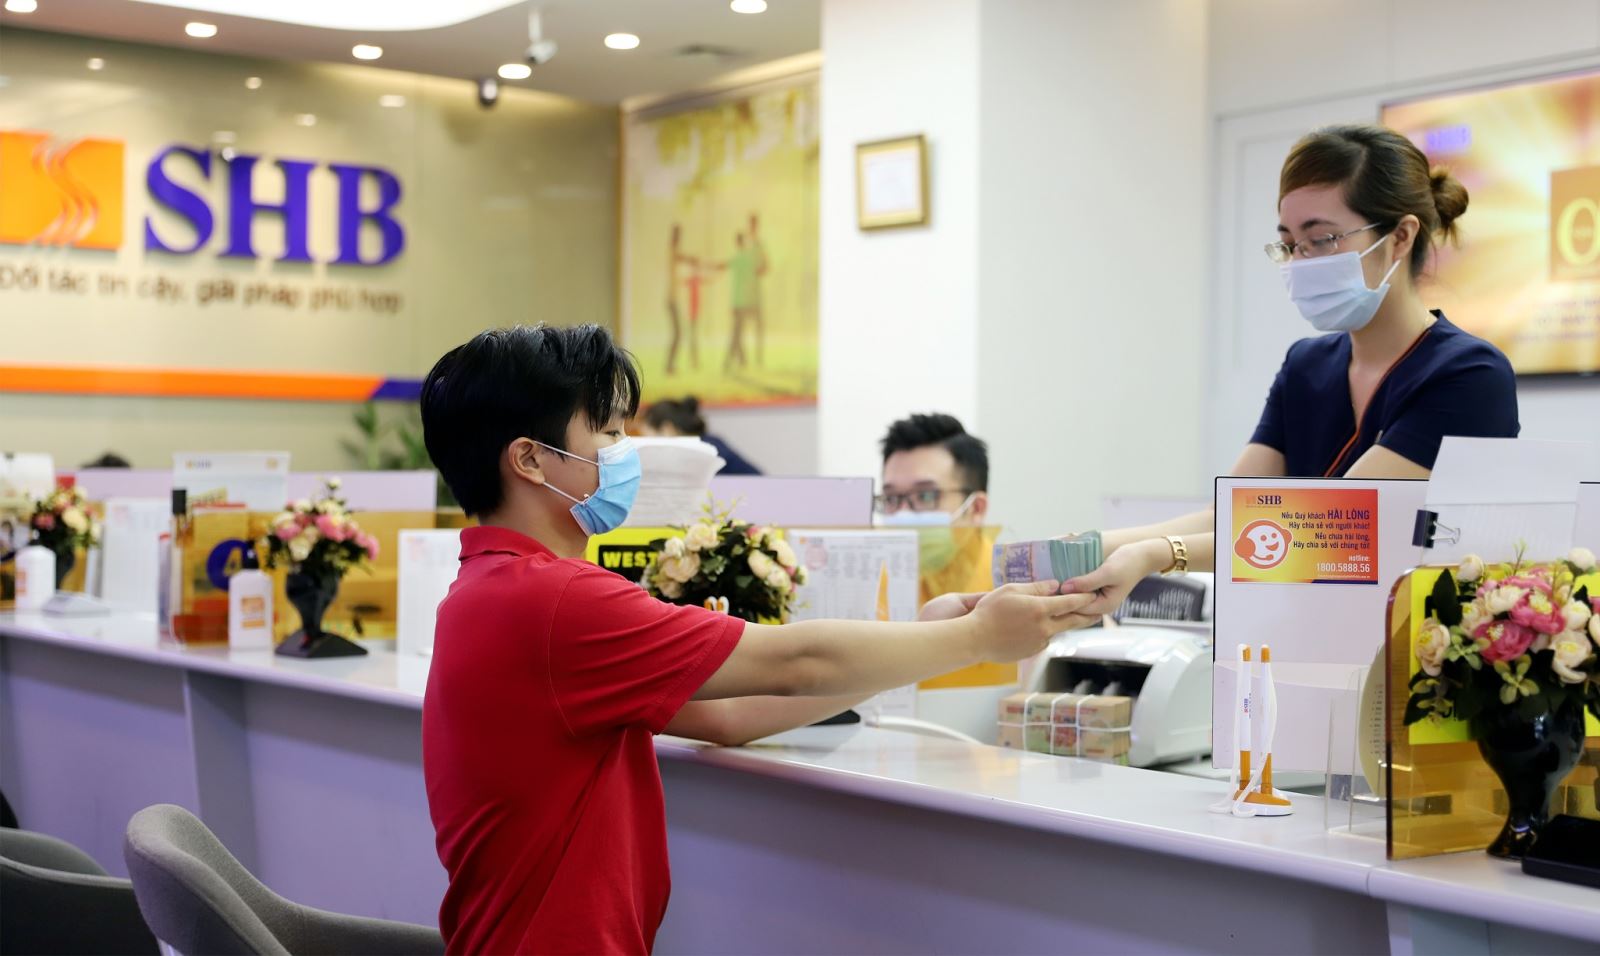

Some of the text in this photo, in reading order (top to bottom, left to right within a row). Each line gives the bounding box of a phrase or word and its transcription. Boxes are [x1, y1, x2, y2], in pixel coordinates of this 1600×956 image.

[144, 144, 406, 266] SHB
[1258, 495, 1281, 504] SHB
[1307, 511, 1325, 519] khách
[1328, 508, 1343, 519] HÀI
[1346, 508, 1370, 520] LÒNG
[1302, 521, 1315, 529] chia
[1316, 563, 1370, 573] 1800.5888.56
